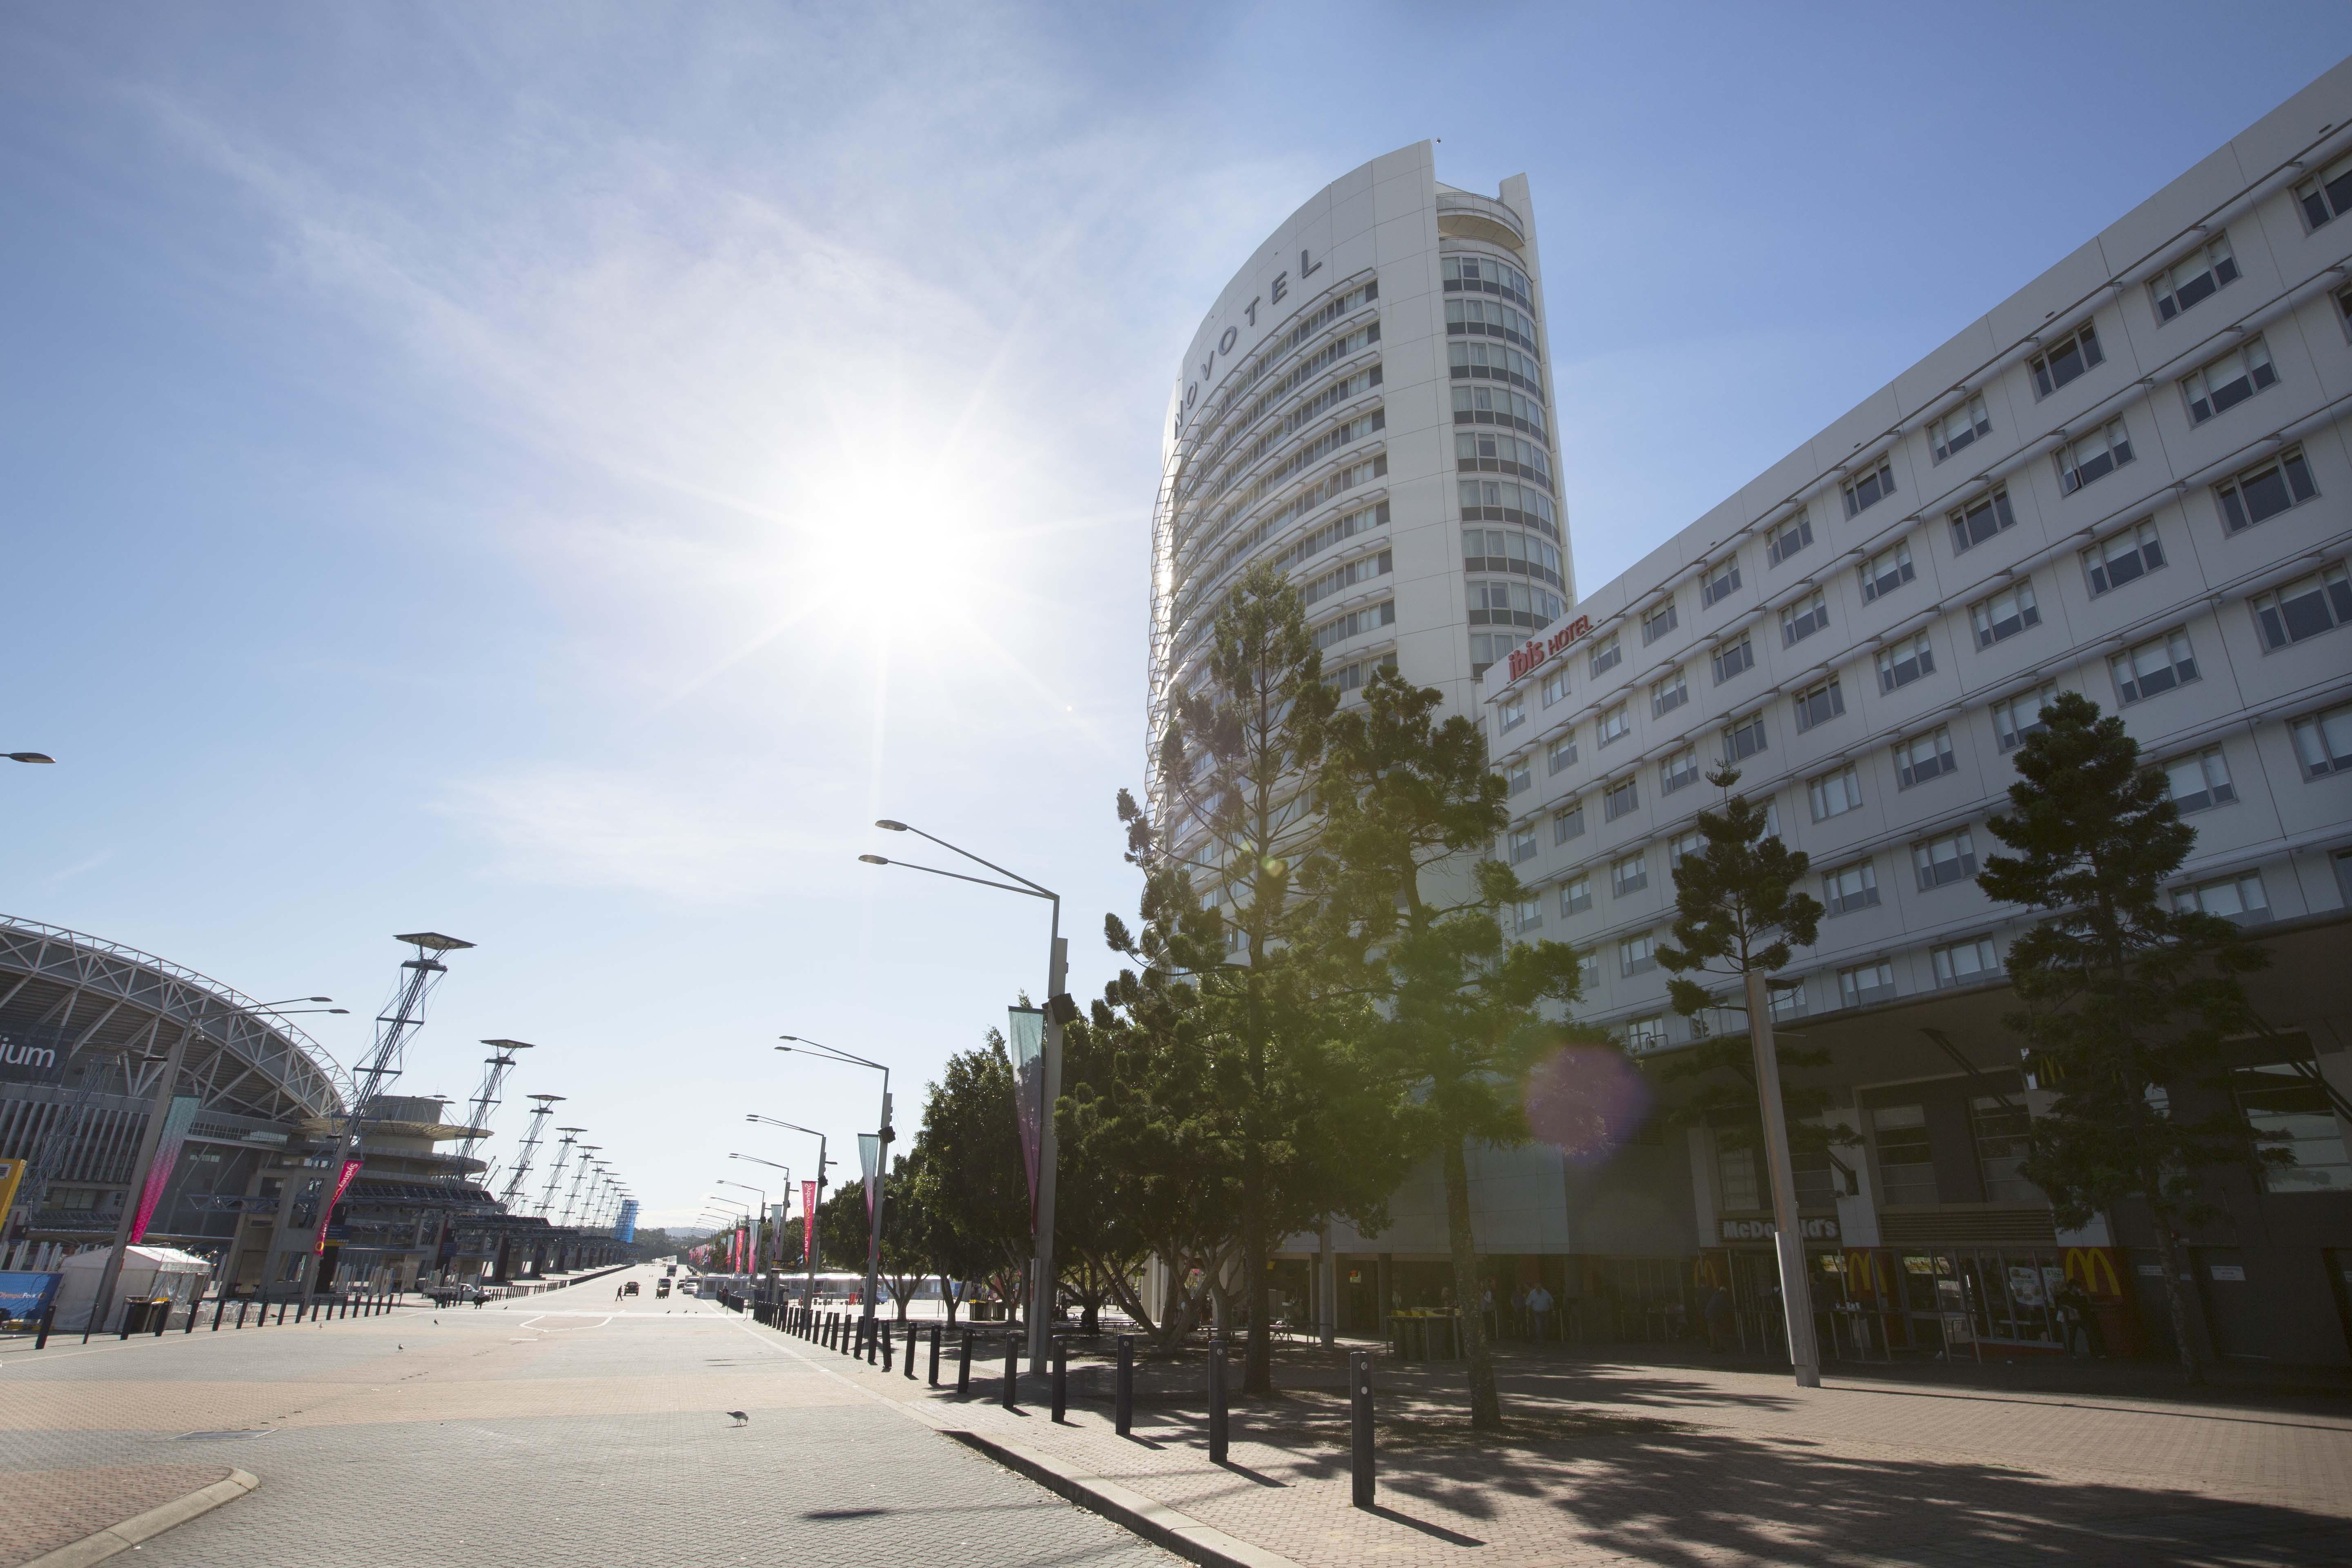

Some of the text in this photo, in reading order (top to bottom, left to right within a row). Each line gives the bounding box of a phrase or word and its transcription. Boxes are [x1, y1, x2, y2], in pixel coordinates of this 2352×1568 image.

[1174, 249, 1322, 440] NOVOTEL
[1508, 614, 1594, 681] ibis HOTEL
[0, 1035, 55, 1067] ium
[1723, 1218, 1838, 1238] McDold's
